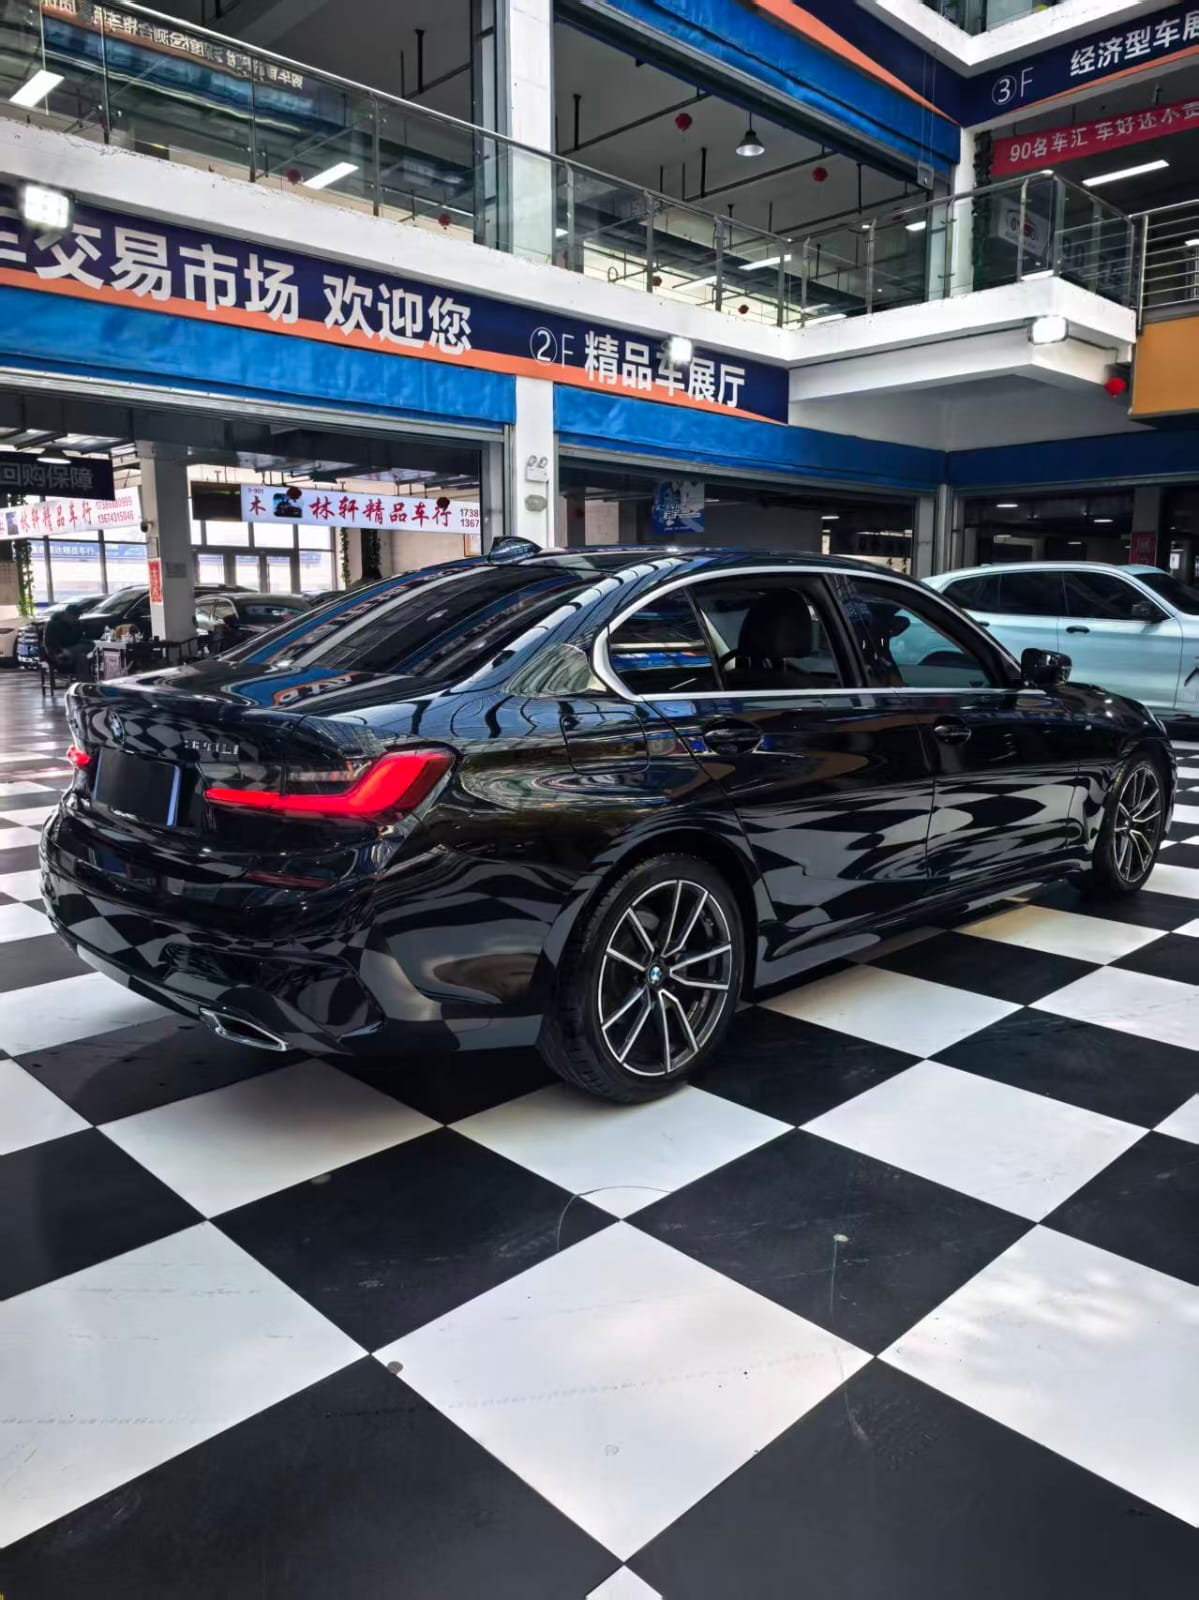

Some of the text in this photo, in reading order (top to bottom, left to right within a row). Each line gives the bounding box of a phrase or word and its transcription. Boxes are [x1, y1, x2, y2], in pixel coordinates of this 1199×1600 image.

[322, 274, 472, 356] 欢迎您
[584, 330, 746, 408] 精品车展厅
[249, 495, 452, 528] 木 林轩精品车行
